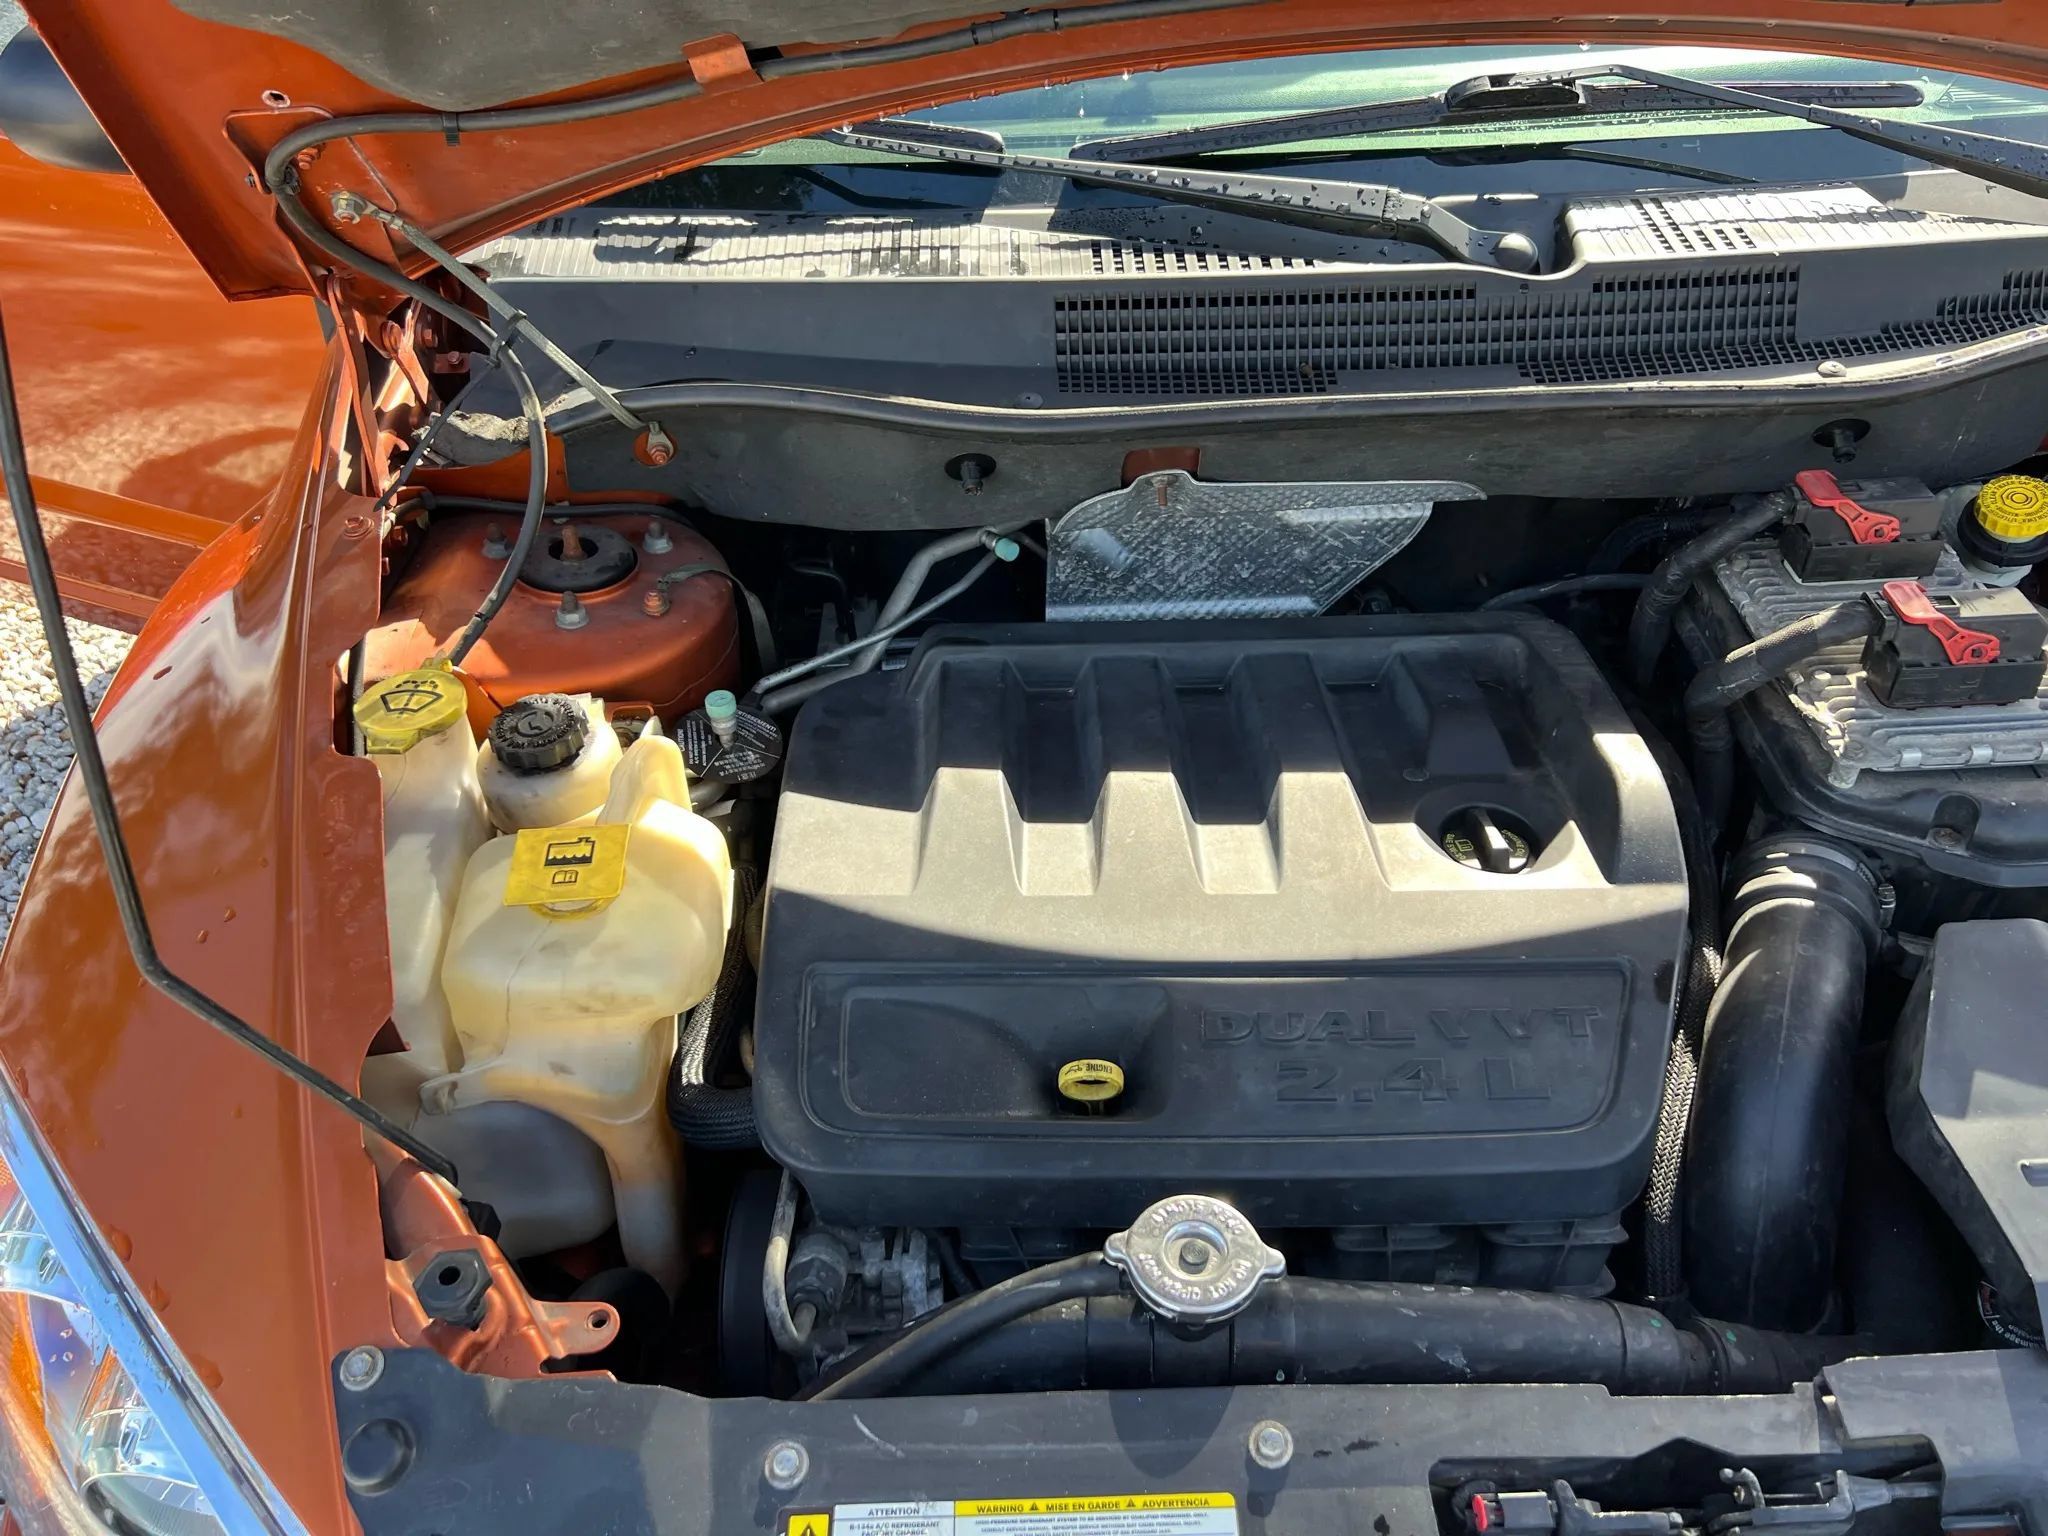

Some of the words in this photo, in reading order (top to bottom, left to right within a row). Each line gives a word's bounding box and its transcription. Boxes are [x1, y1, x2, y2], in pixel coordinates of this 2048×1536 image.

[1202, 1009, 1416, 1045] DUAL
[1430, 1005, 1602, 1042] VVT
[1085, 1063, 1113, 1074] ENGINE
[867, 1506, 920, 1517] ATTENTION
[976, 1503, 1024, 1514] WARNING
[1045, 1502, 1071, 1512] MISE
[1072, 1501, 1086, 1511] EN
[1087, 1500, 1121, 1510] GARDE
[1142, 1498, 1211, 1508] ADVERTENCIA
